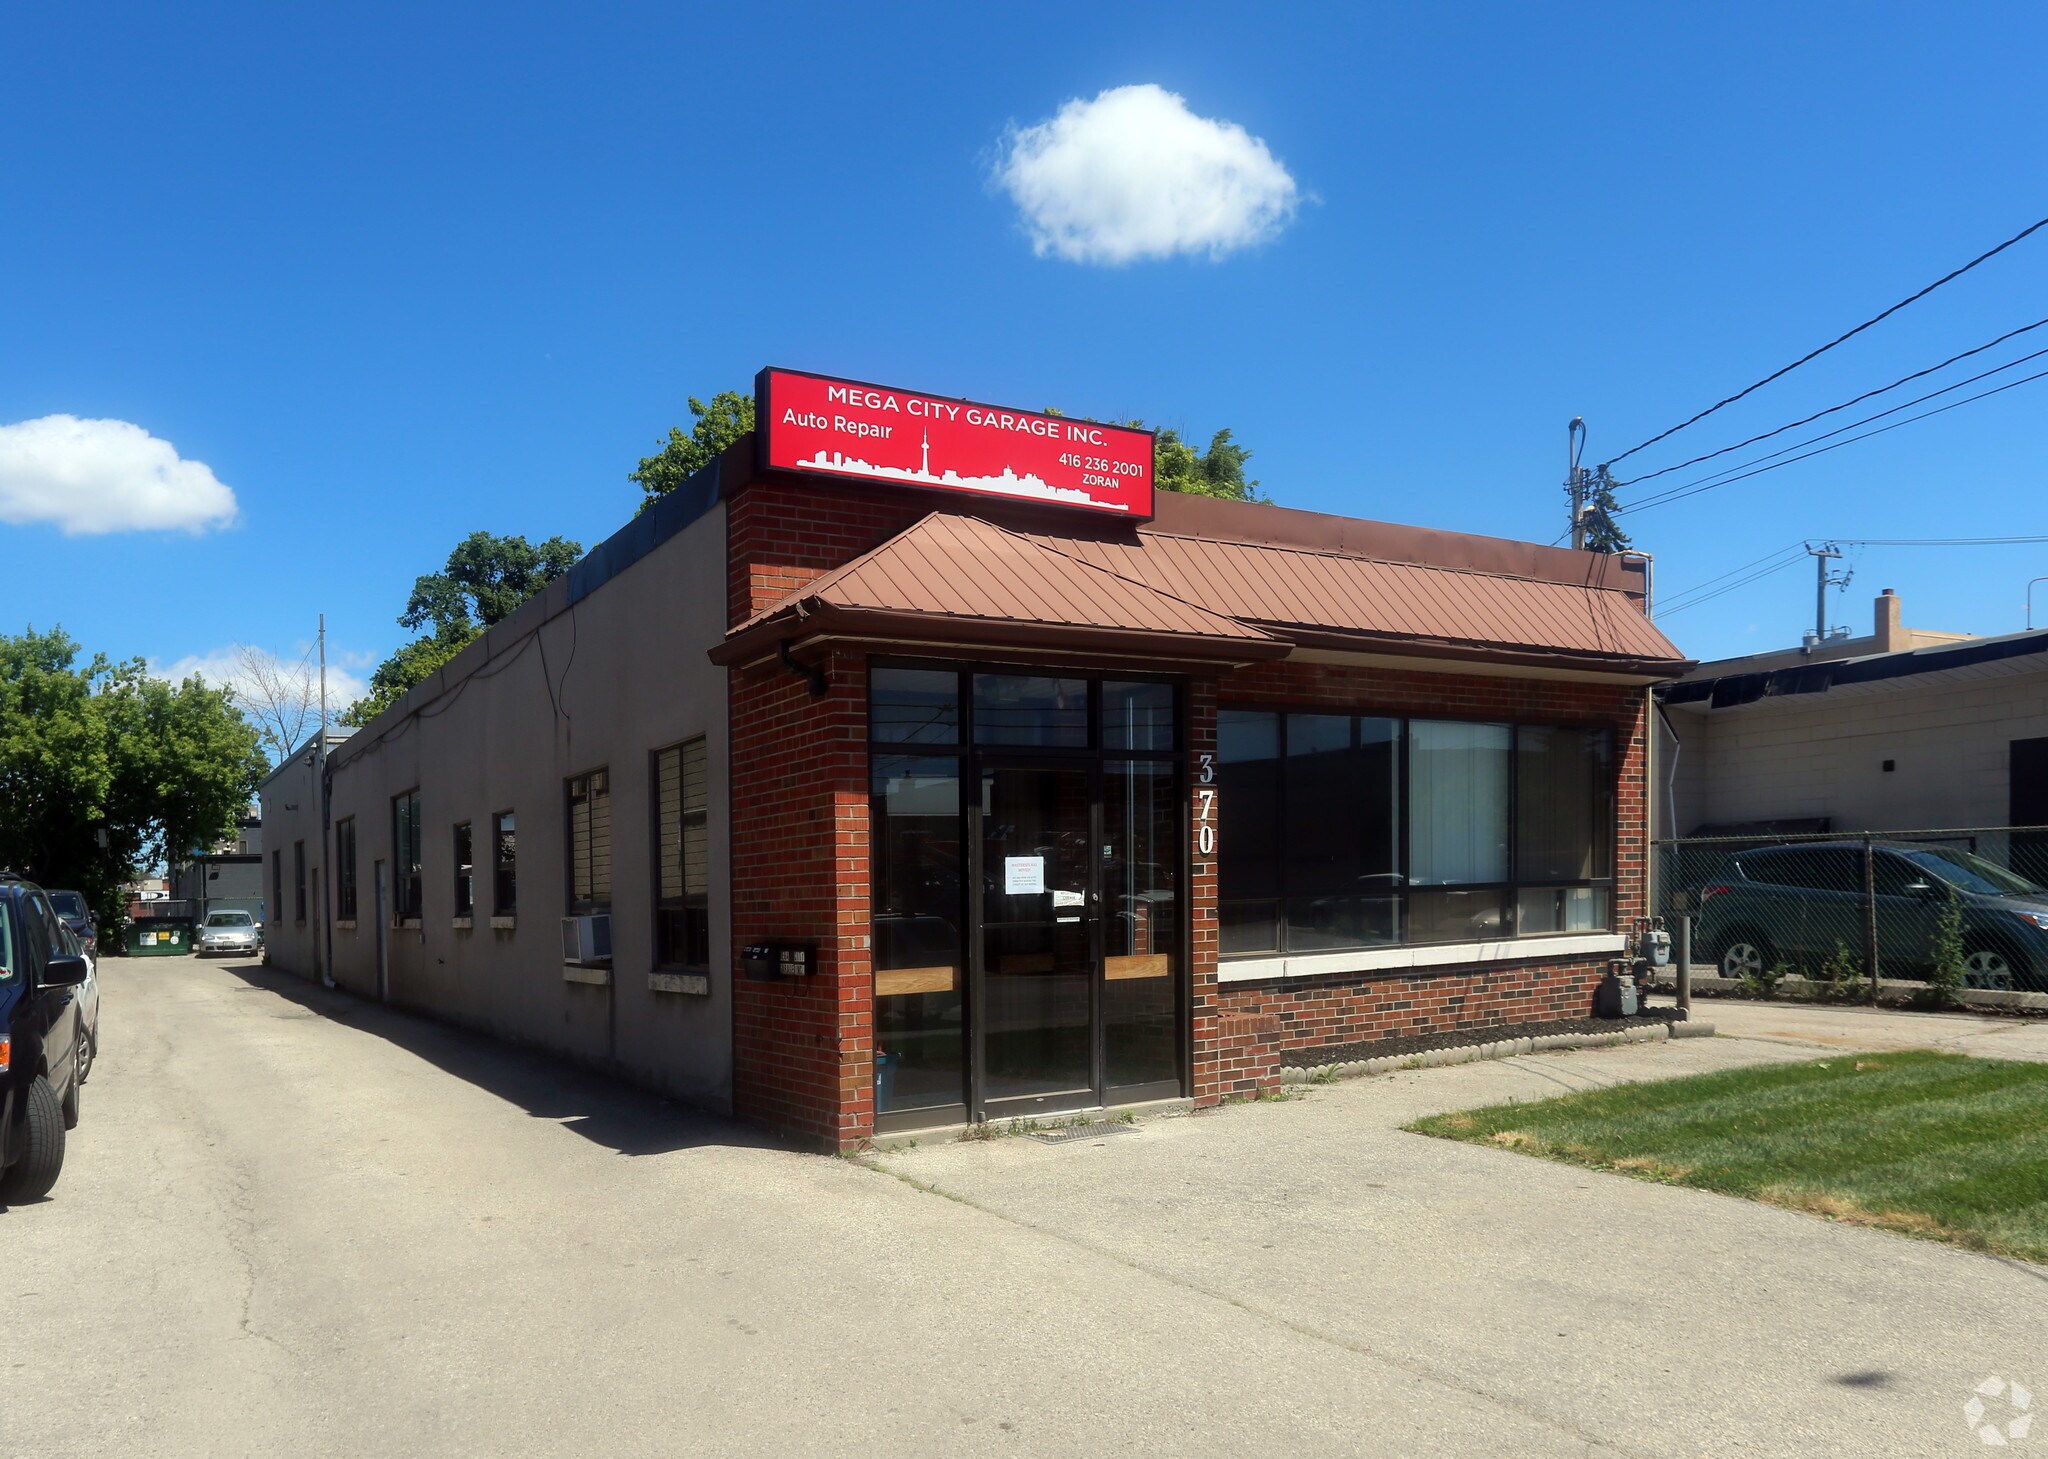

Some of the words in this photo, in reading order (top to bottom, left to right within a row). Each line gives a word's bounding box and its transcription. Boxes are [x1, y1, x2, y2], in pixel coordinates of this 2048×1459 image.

[782, 408, 828, 430] Auto
[834, 415, 893, 439] Repair
[828, 385, 900, 413] MEGA
[906, 399, 960, 422] CITY
[966, 409, 1060, 439] GARAGE
[1066, 425, 1108, 447] INC.
[1058, 452, 1081, 468] 416
[1084, 456, 1109, 472] 236
[1112, 460, 1144, 478] 2001
[1082, 473, 1120, 489] ZORAN
[1199, 754, 1214, 854] 370
